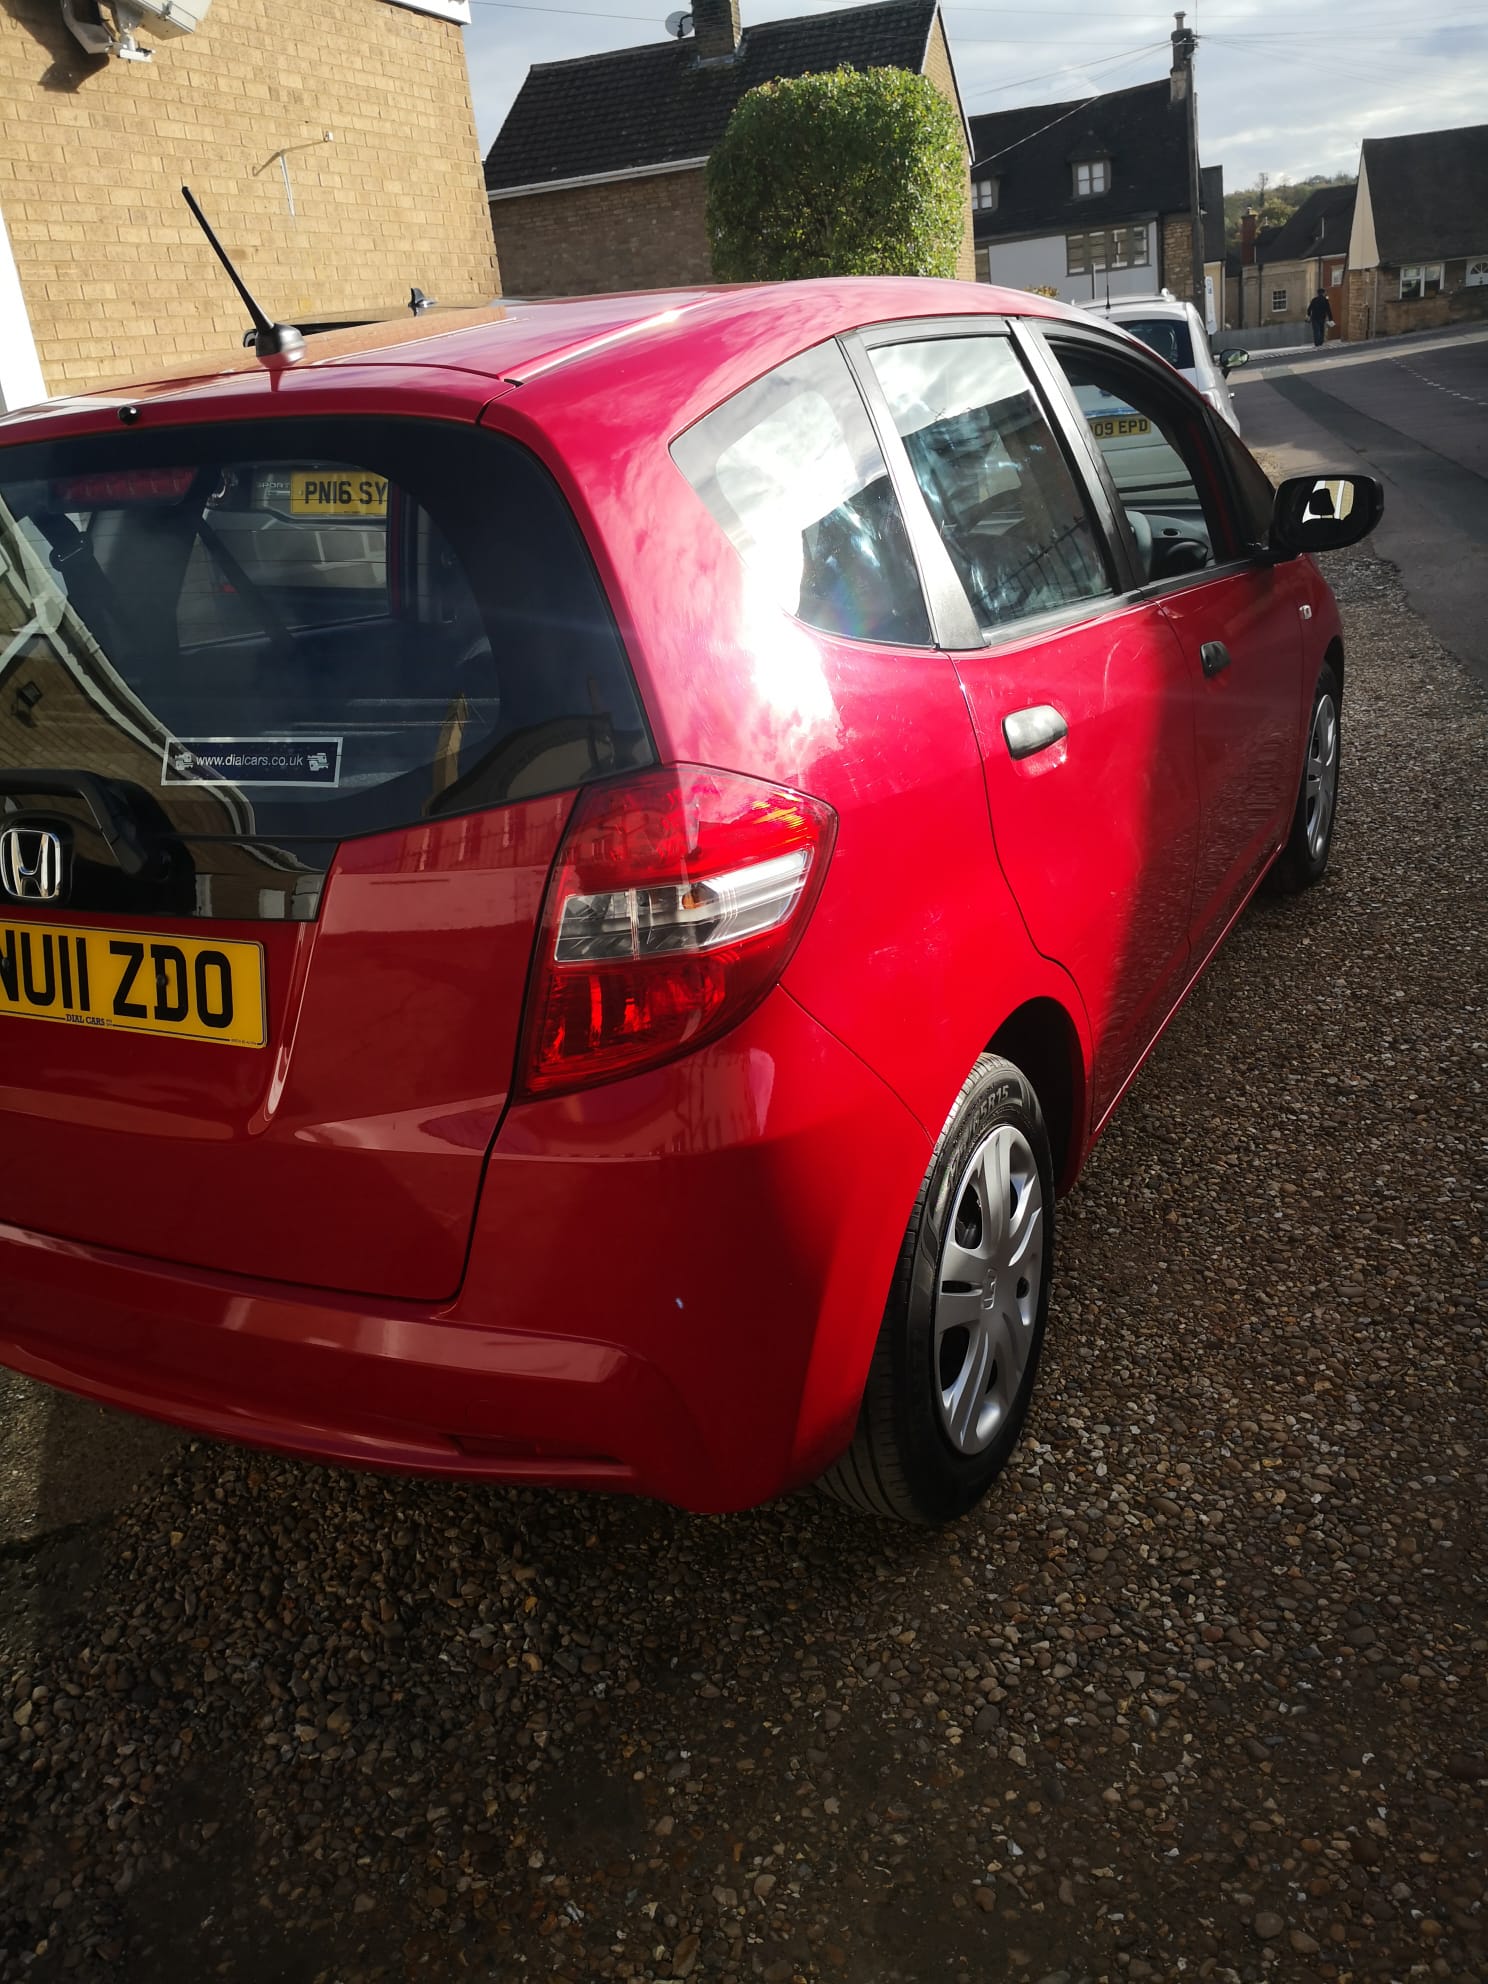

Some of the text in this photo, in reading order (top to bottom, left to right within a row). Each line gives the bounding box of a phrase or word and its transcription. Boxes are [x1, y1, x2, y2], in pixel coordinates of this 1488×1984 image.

[1090, 419, 1148, 437] 09 EPD
[304, 480, 352, 505] PN16
[196, 753, 303, 767] www.dialcars.co.uk
[109, 940, 234, 1028] ZDO
[65, 1013, 84, 1024] DIAL
[86, 1014, 105, 1026] CARS
